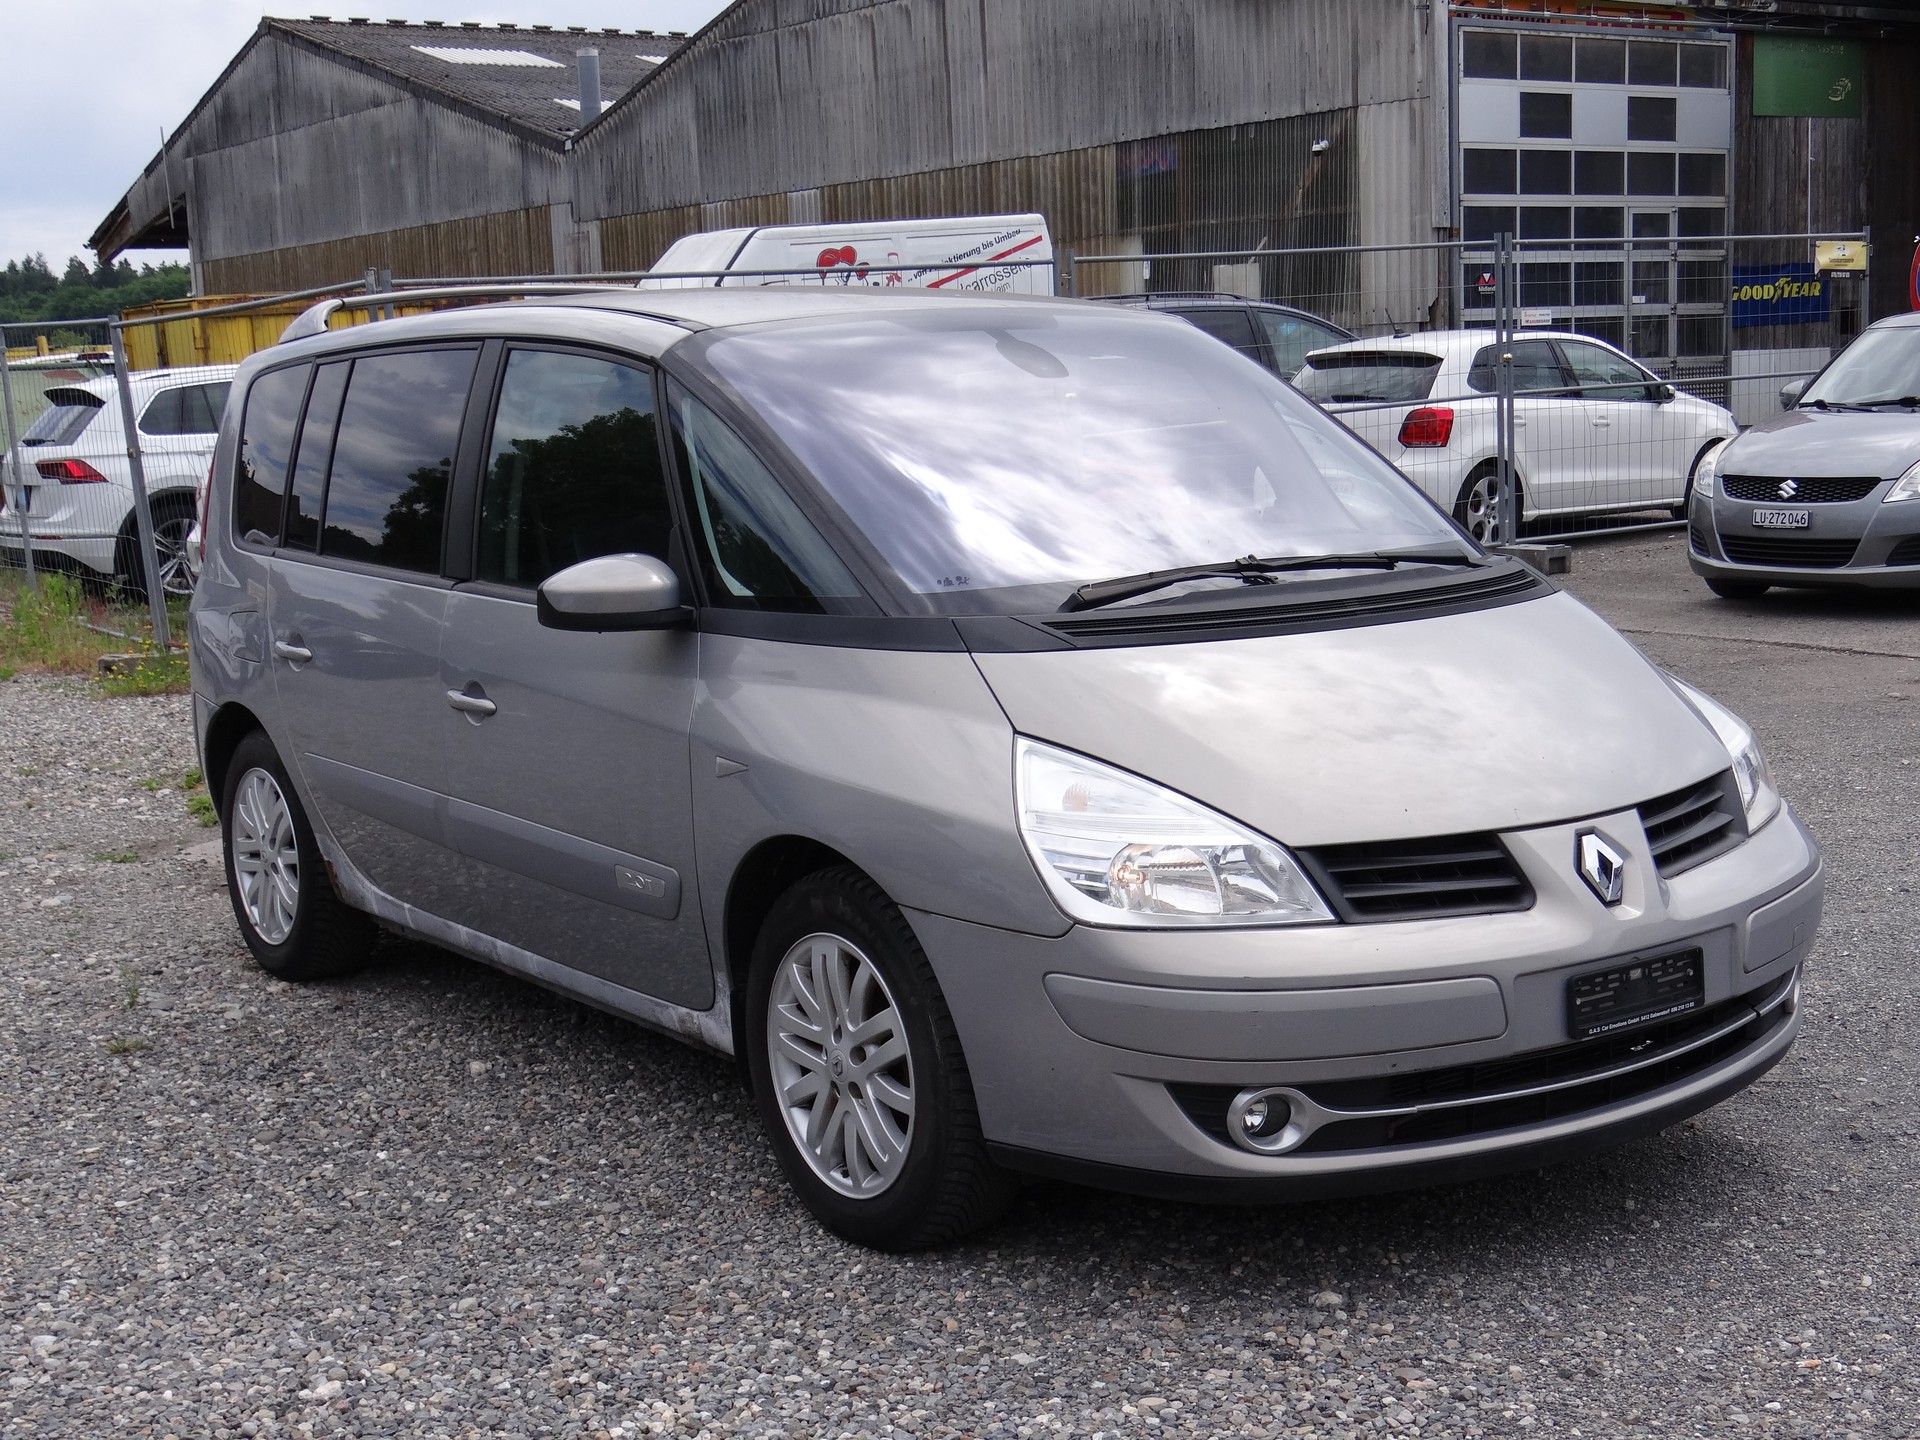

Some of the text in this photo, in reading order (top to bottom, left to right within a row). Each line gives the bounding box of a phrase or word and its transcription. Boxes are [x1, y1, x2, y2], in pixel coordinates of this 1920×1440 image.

[981, 239, 994, 251] bis
[994, 228, 1021, 245] Umbau
[1732, 278, 1822, 303] GOODYEAR
